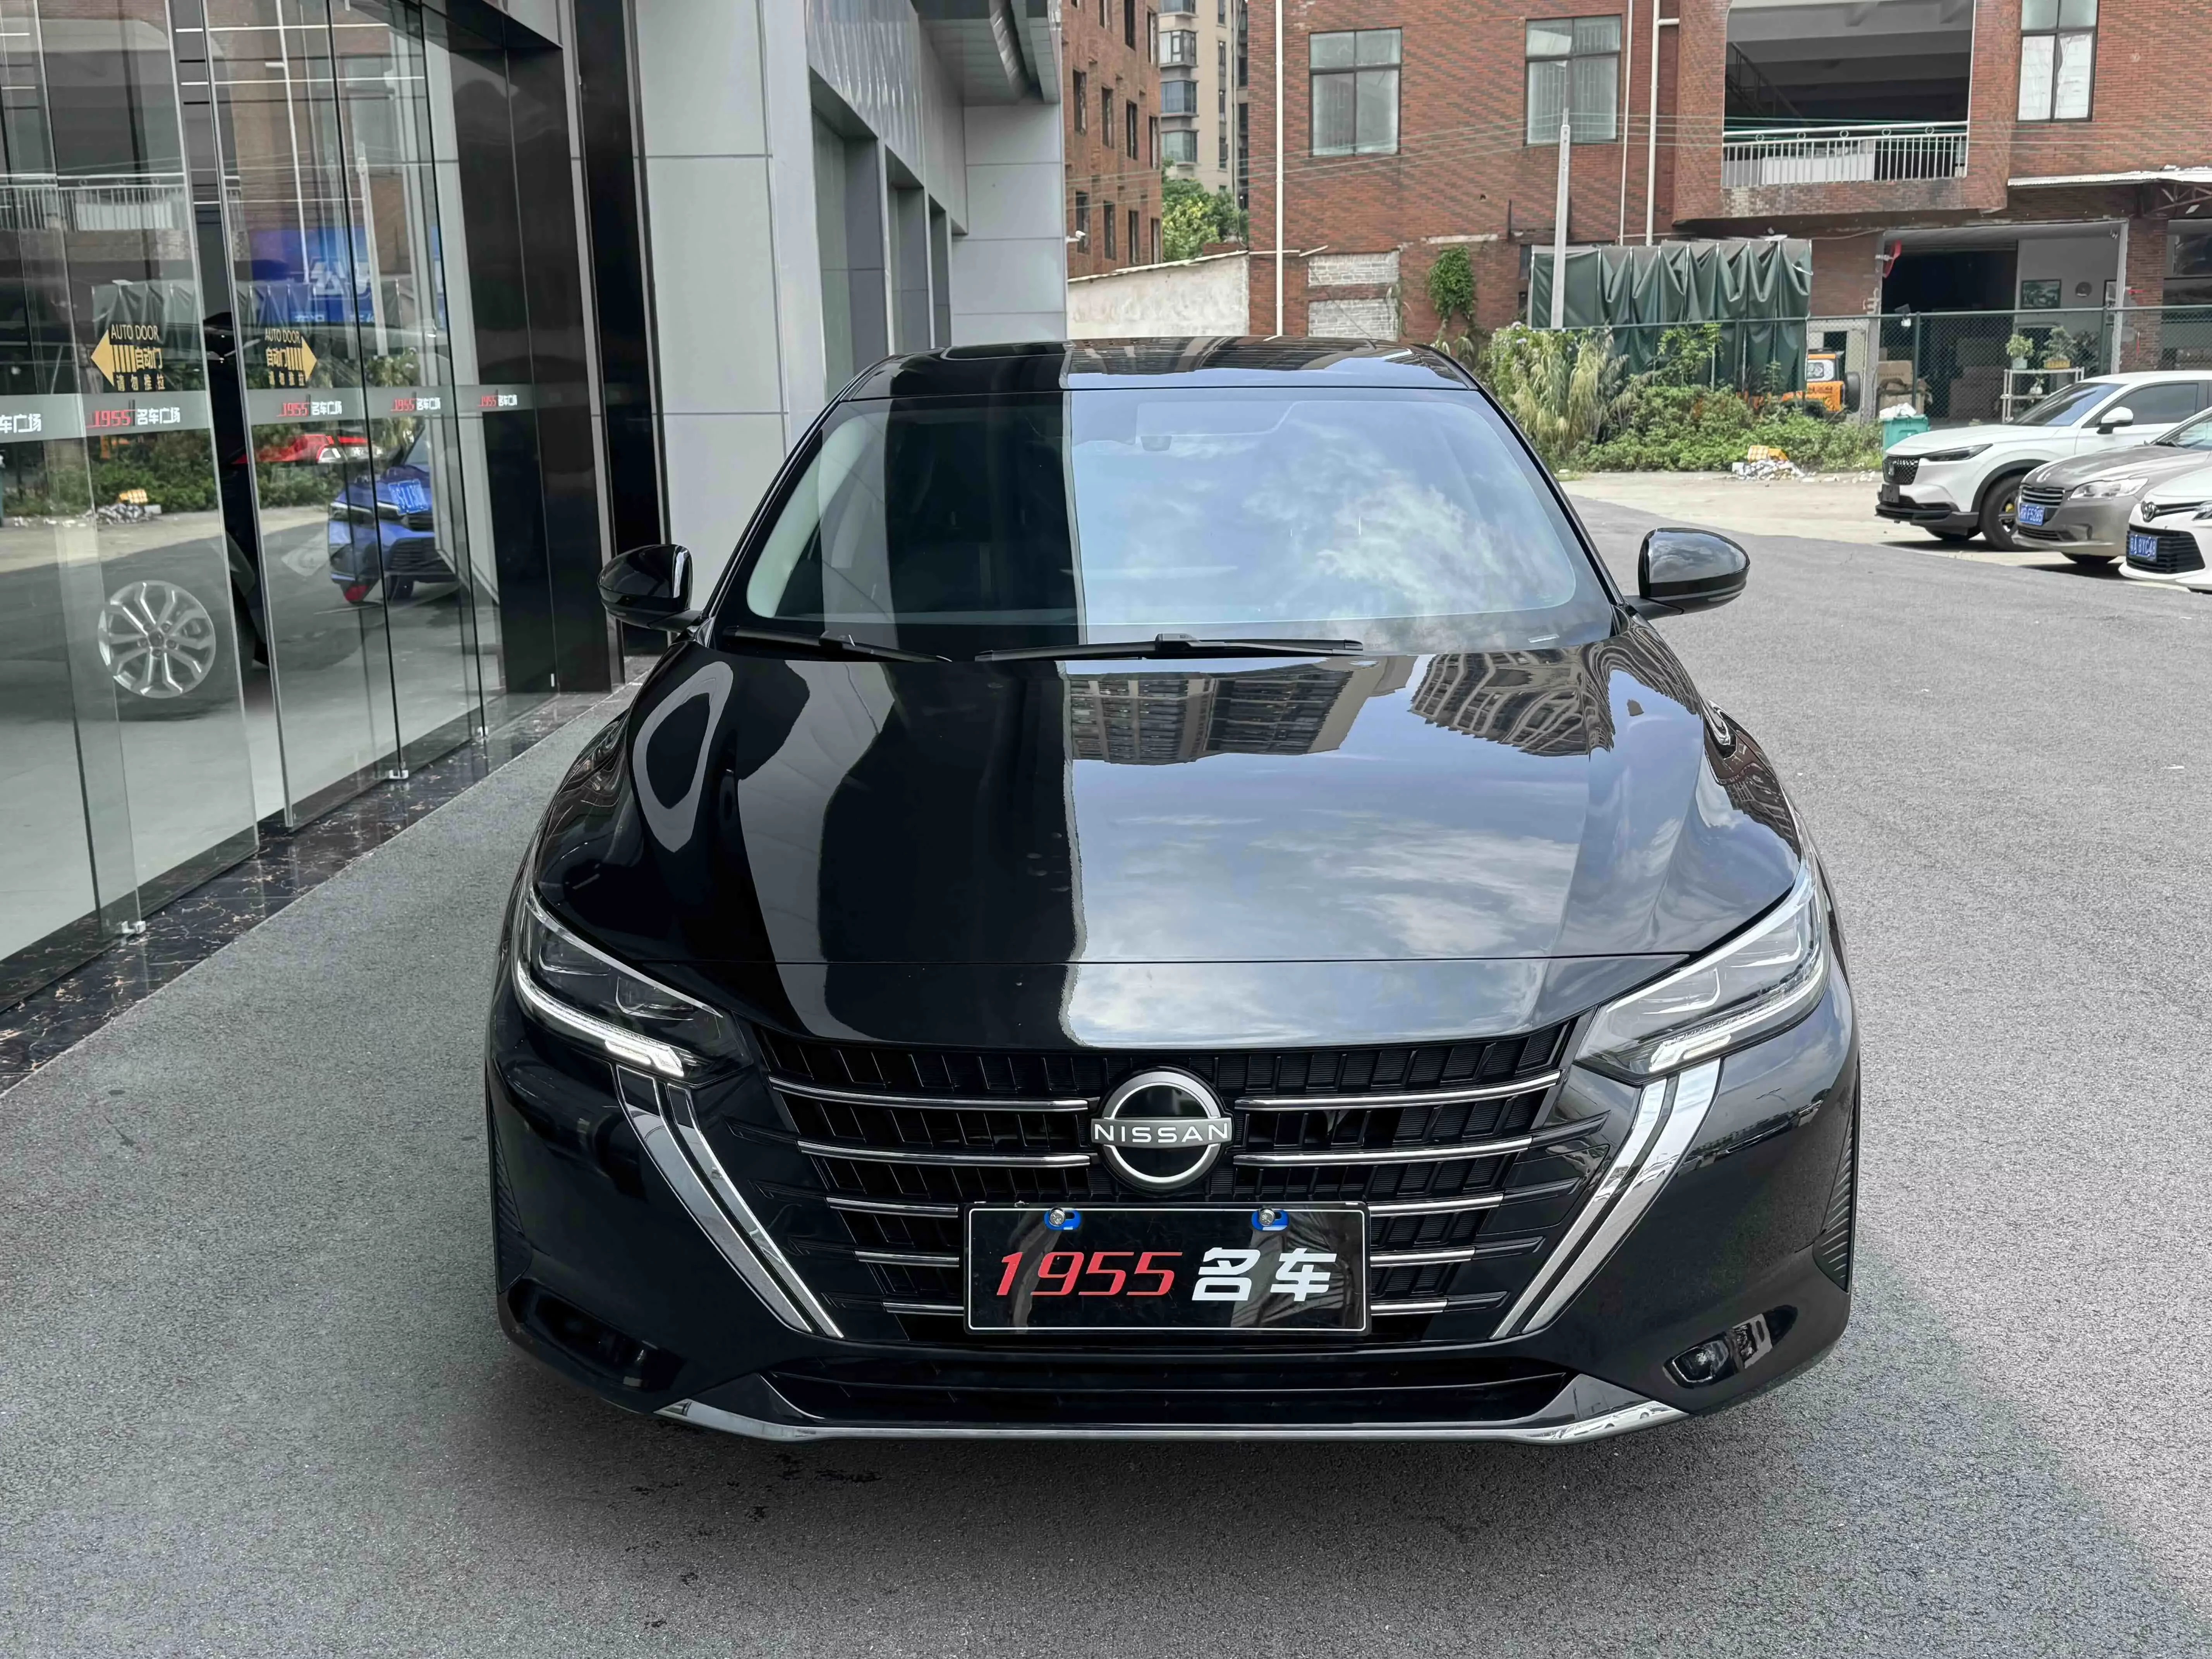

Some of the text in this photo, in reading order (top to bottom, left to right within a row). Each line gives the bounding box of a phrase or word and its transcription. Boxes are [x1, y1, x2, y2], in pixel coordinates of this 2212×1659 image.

[111, 324, 160, 340] AUTO DOOR
[265, 328, 300, 343] AUTO DOOR
[136, 347, 163, 369] 自动门
[266, 347, 287, 368] 自动门
[91, 407, 180, 427] 1955 名车广场
[281, 401, 342, 417] 1955 名车广场
[1094, 1123, 1228, 1143] NISSAN
[996, 1247, 1337, 1302] 1955 名车
